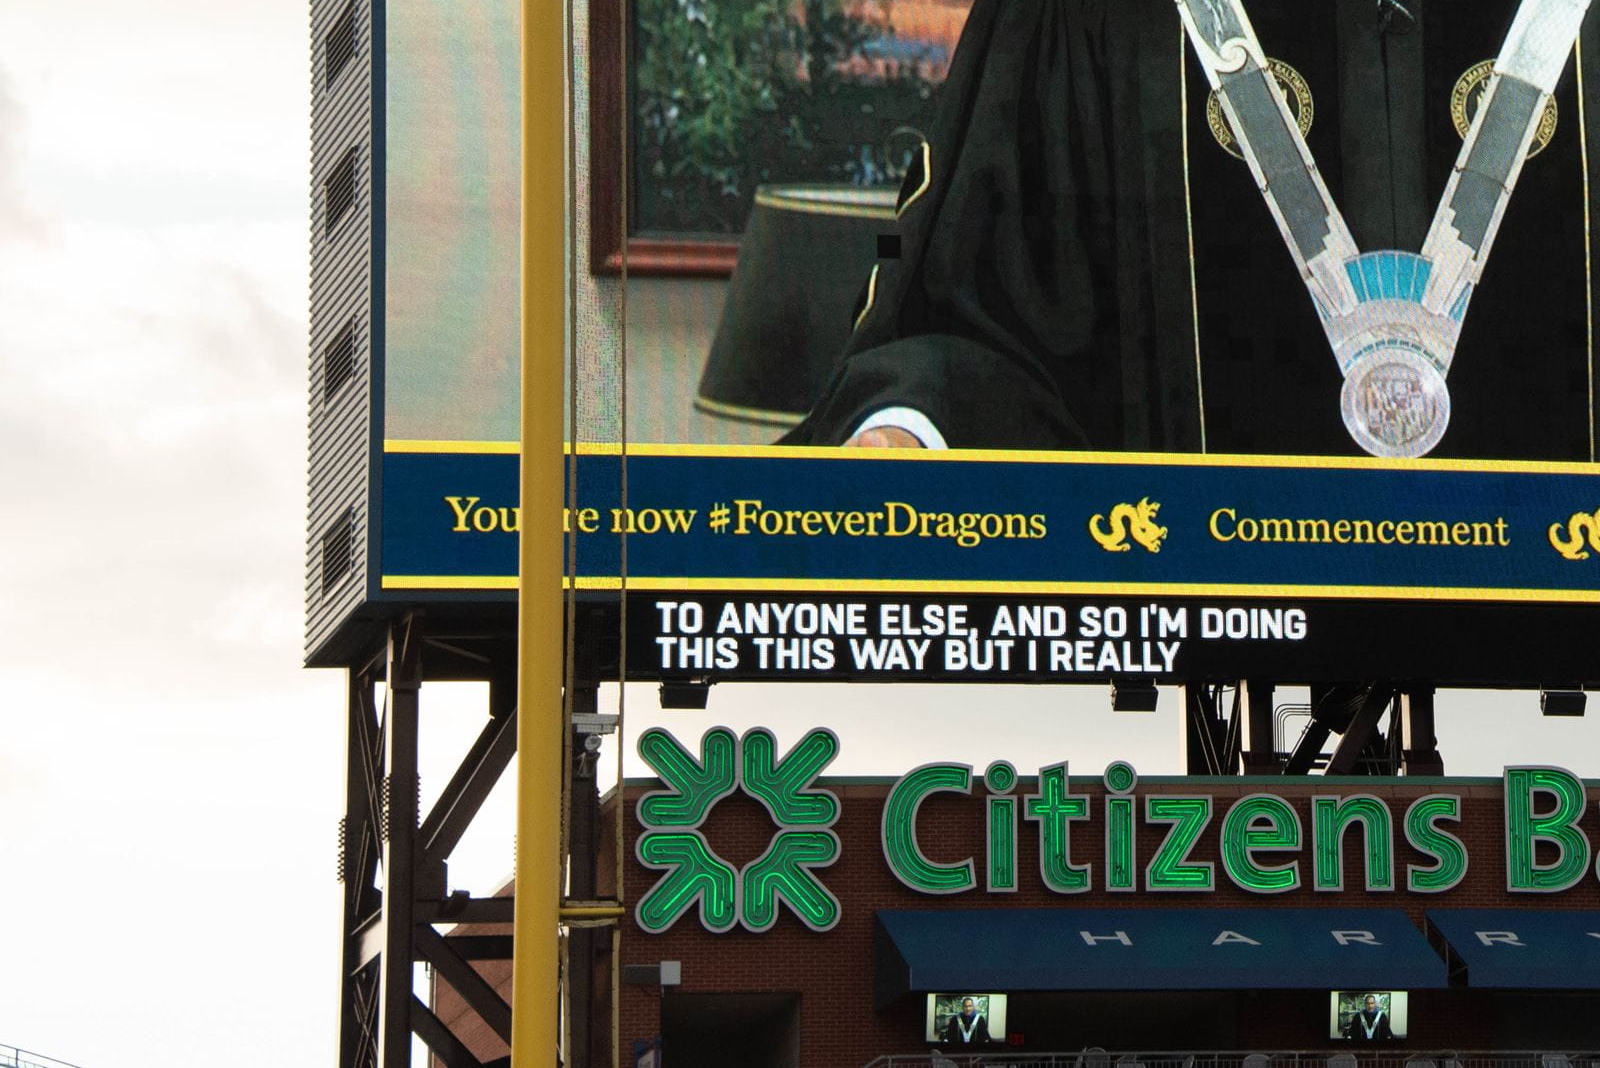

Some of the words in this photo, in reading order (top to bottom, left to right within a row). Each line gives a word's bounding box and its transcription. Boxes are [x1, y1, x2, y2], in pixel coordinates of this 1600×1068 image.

[445, 496, 520, 533] You
[562, 505, 600, 533] re
[611, 507, 698, 534] now
[709, 499, 1047, 547] #ForeverDragons
[1209, 507, 1511, 546] Commencement
[655, 601, 703, 633] TO
[716, 602, 867, 636] ANYONE
[991, 605, 1066, 637] AND
[1079, 606, 1127, 637] SO
[1140, 603, 1187, 637] I'M
[1201, 607, 1307, 639] DOING
[655, 637, 740, 669] THIS
[753, 637, 835, 669] THIS
[850, 638, 931, 670] WAY
[945, 639, 1014, 671] BUT
[1028, 640, 1037, 671] I
[1050, 641, 1181, 672] REALLY
[881, 759, 1469, 895] Citizens
